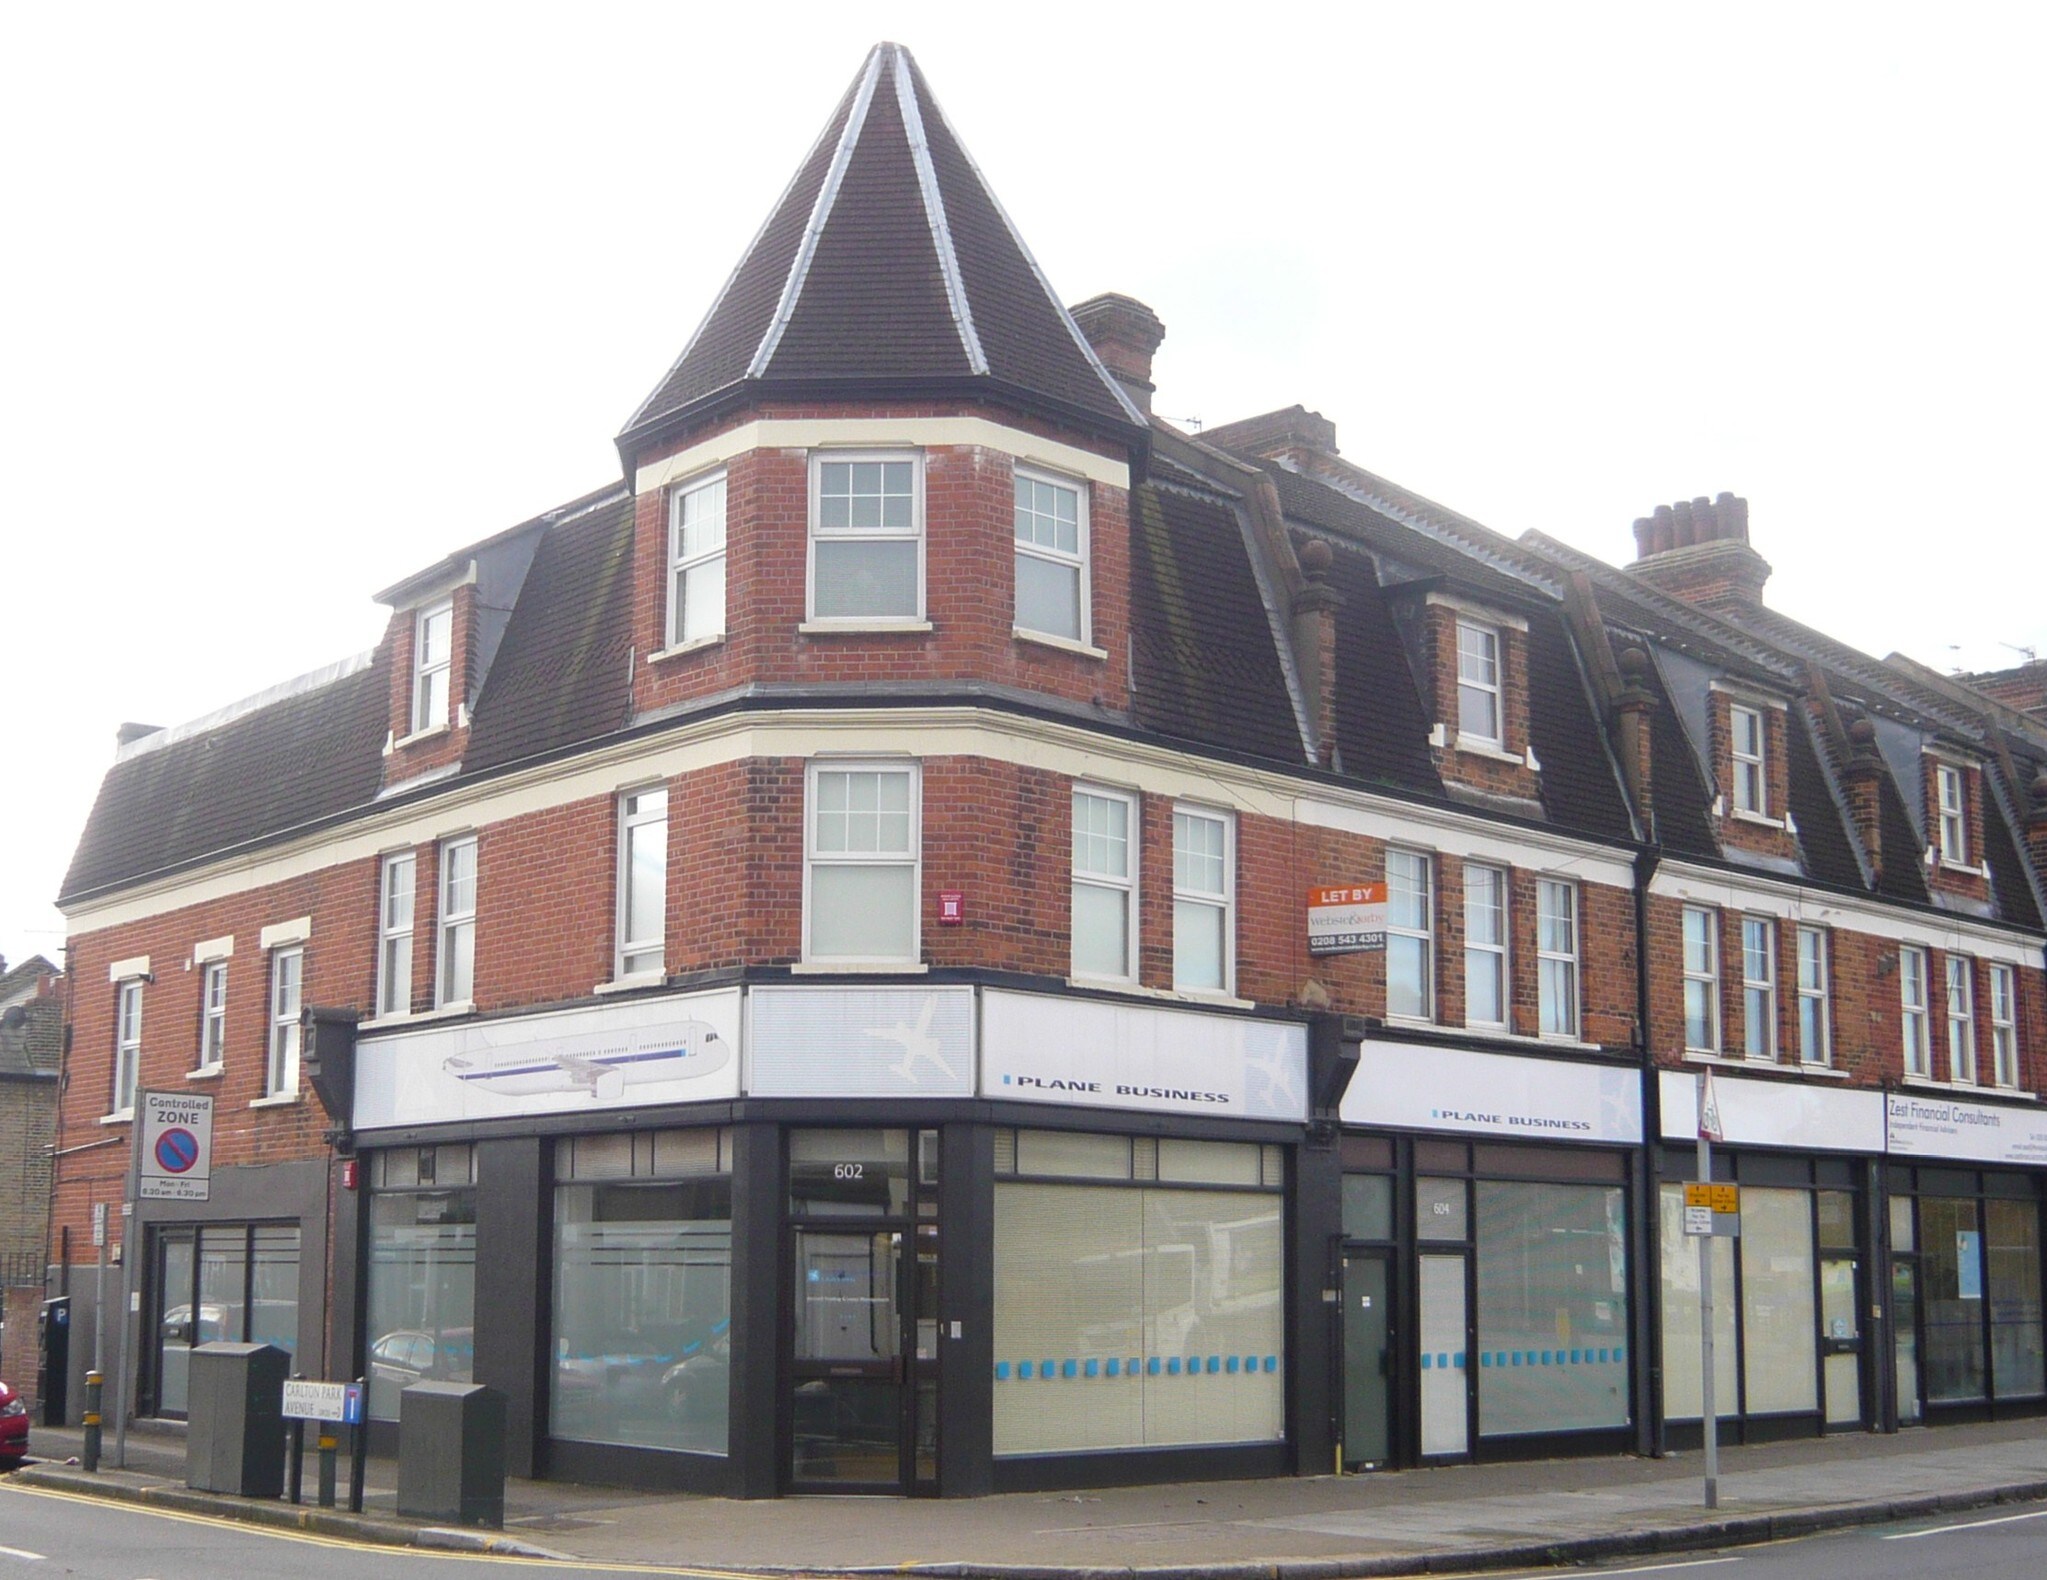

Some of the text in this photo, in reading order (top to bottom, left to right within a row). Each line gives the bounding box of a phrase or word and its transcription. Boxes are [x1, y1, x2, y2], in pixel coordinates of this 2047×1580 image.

[1321, 887, 1373, 903] LET BY
[1310, 933, 1383, 946] 0208 543 4301
[1017, 1076, 1230, 1103] PLANE BUSINESS
[149, 1097, 209, 1111] Controlled
[157, 1111, 199, 1125] ZONE
[1441, 1110, 1591, 1130] PLANE BUSINESS
[1889, 1100, 2001, 1127] Zest Financial Consultants
[834, 1163, 864, 1179] 602
[1433, 1202, 1450, 1215] 604
[57, 1308, 67, 1322] P
[285, 1383, 342, 1400] CARLTON PARK
[284, 1401, 315, 1416] AVENUE
